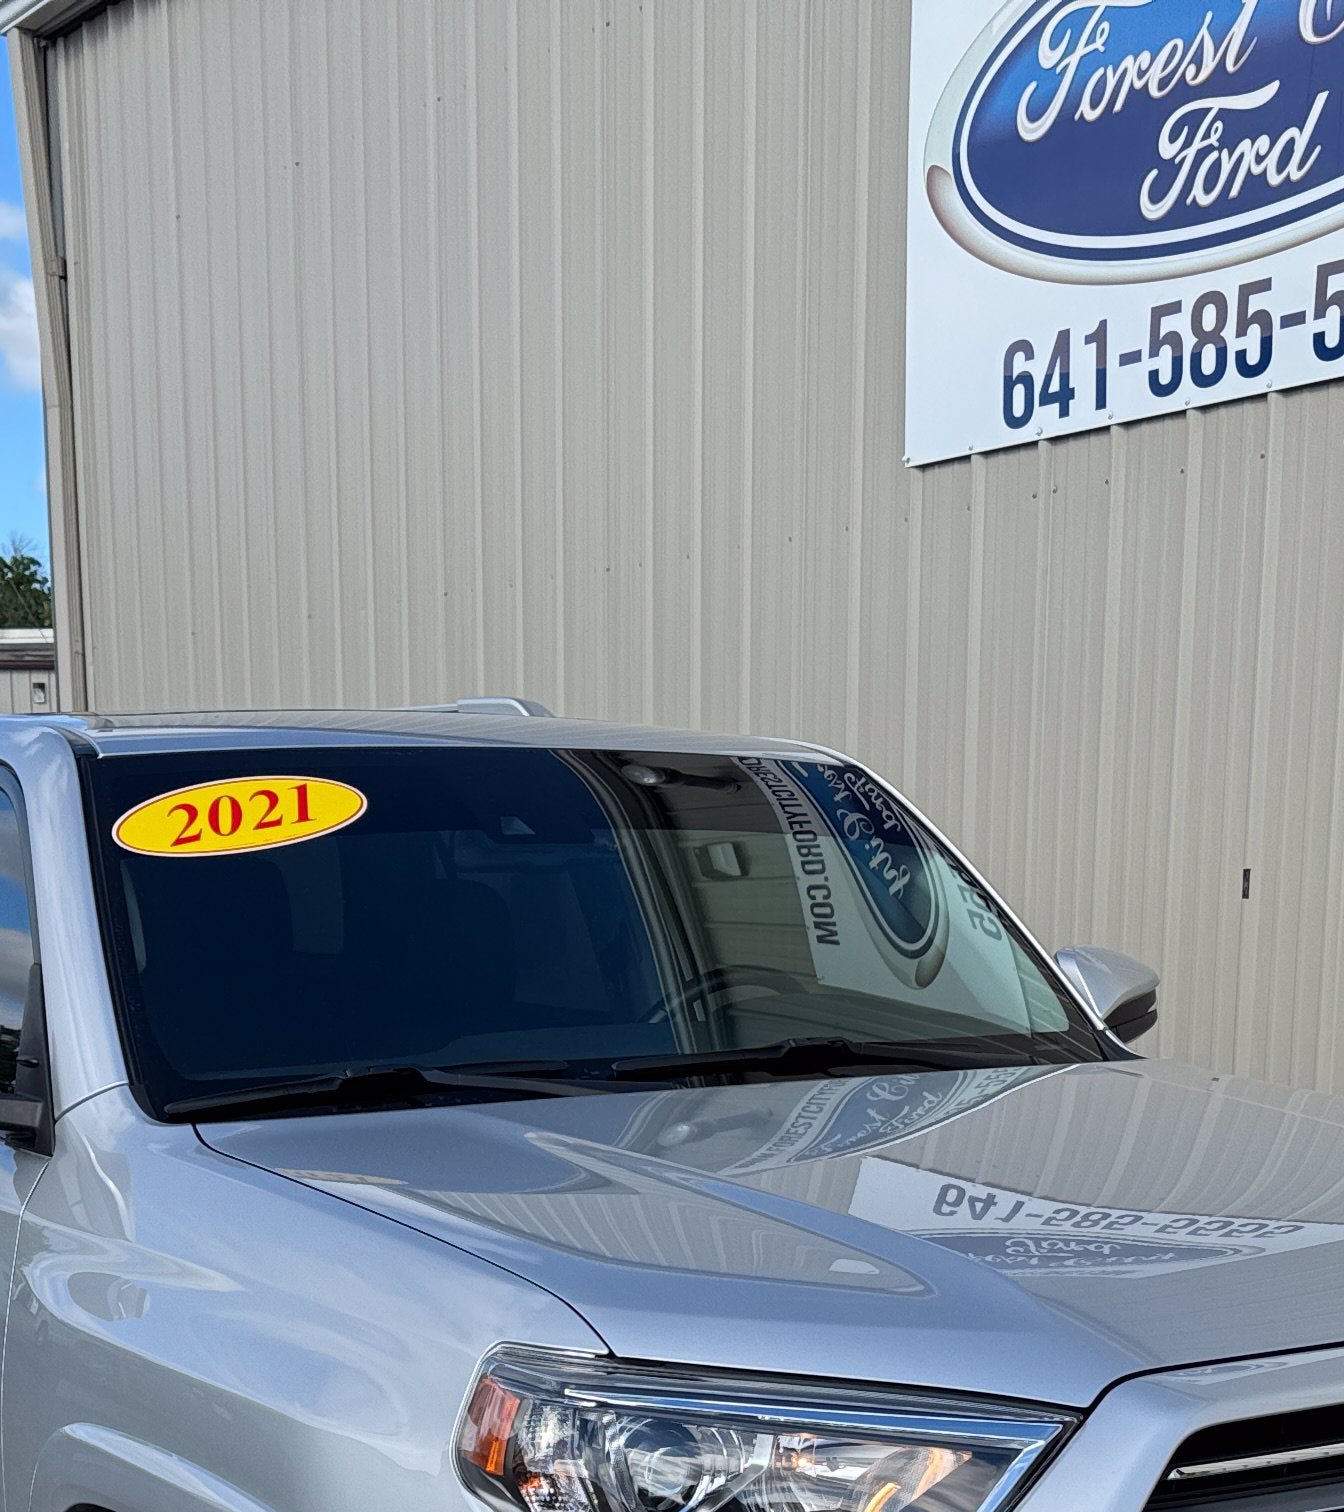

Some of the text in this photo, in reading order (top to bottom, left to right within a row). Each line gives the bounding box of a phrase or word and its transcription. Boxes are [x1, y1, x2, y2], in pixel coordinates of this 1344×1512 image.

[1017, 0, 1257, 142] Forest
[1140, 79, 1330, 221] Ford
[167, 782, 317, 848] 2021
